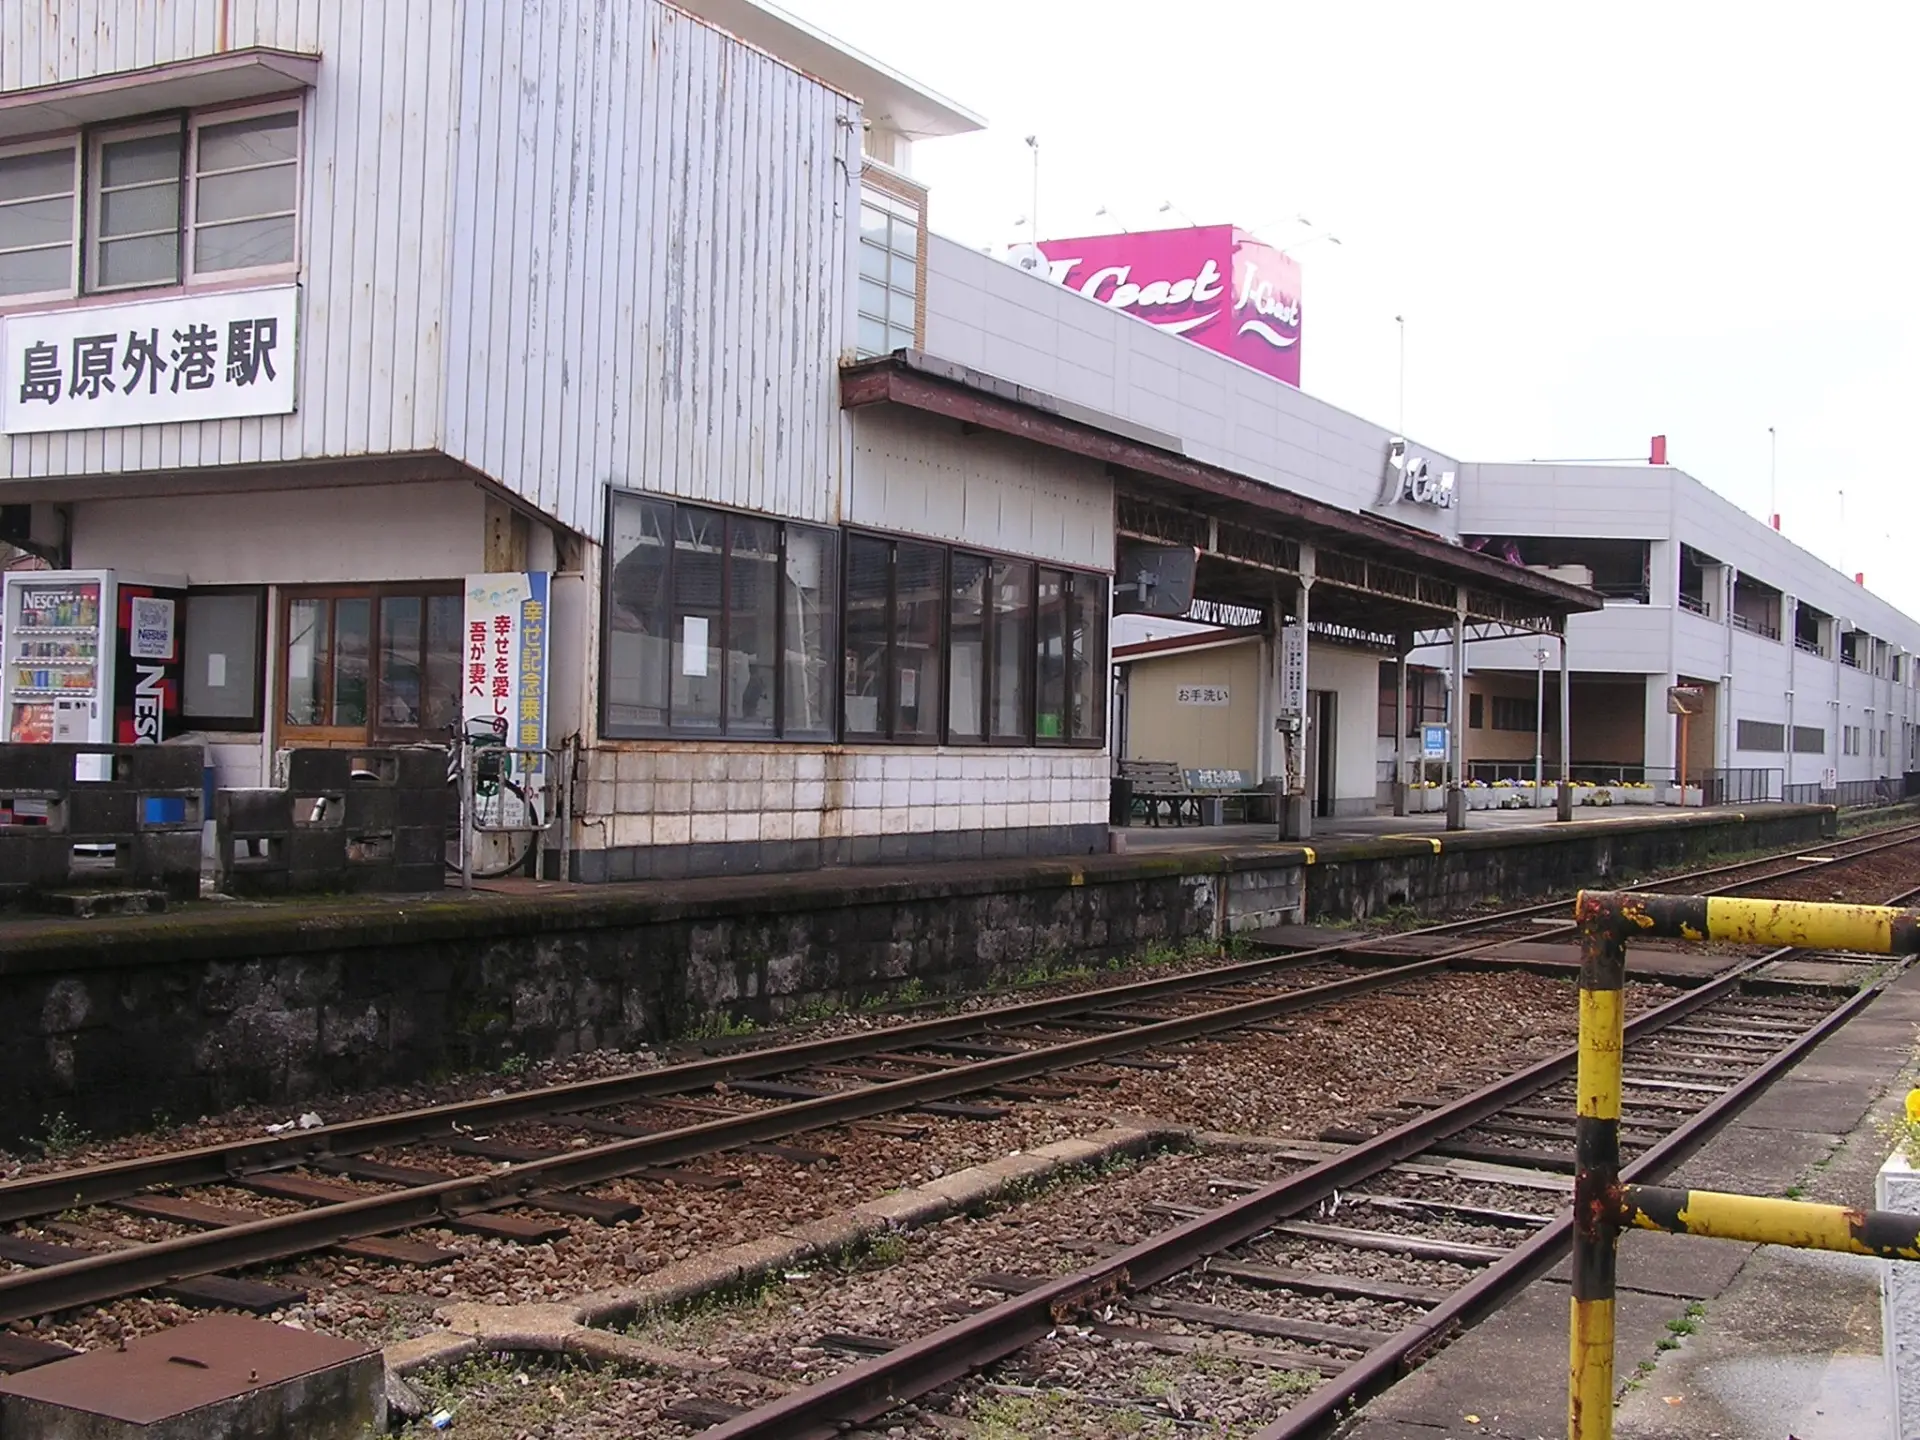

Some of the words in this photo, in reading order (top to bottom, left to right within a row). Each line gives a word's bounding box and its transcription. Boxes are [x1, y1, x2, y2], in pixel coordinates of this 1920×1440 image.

[1079, 259, 1224, 308] Coast
[19, 317, 278, 405] 島原外港駅
[23, 591, 73, 609] NESCA
[468, 621, 487, 697] 吾が妻へ
[491, 614, 511, 734] 幸せを愛しの
[1178, 689, 1229, 702] お手洗い
